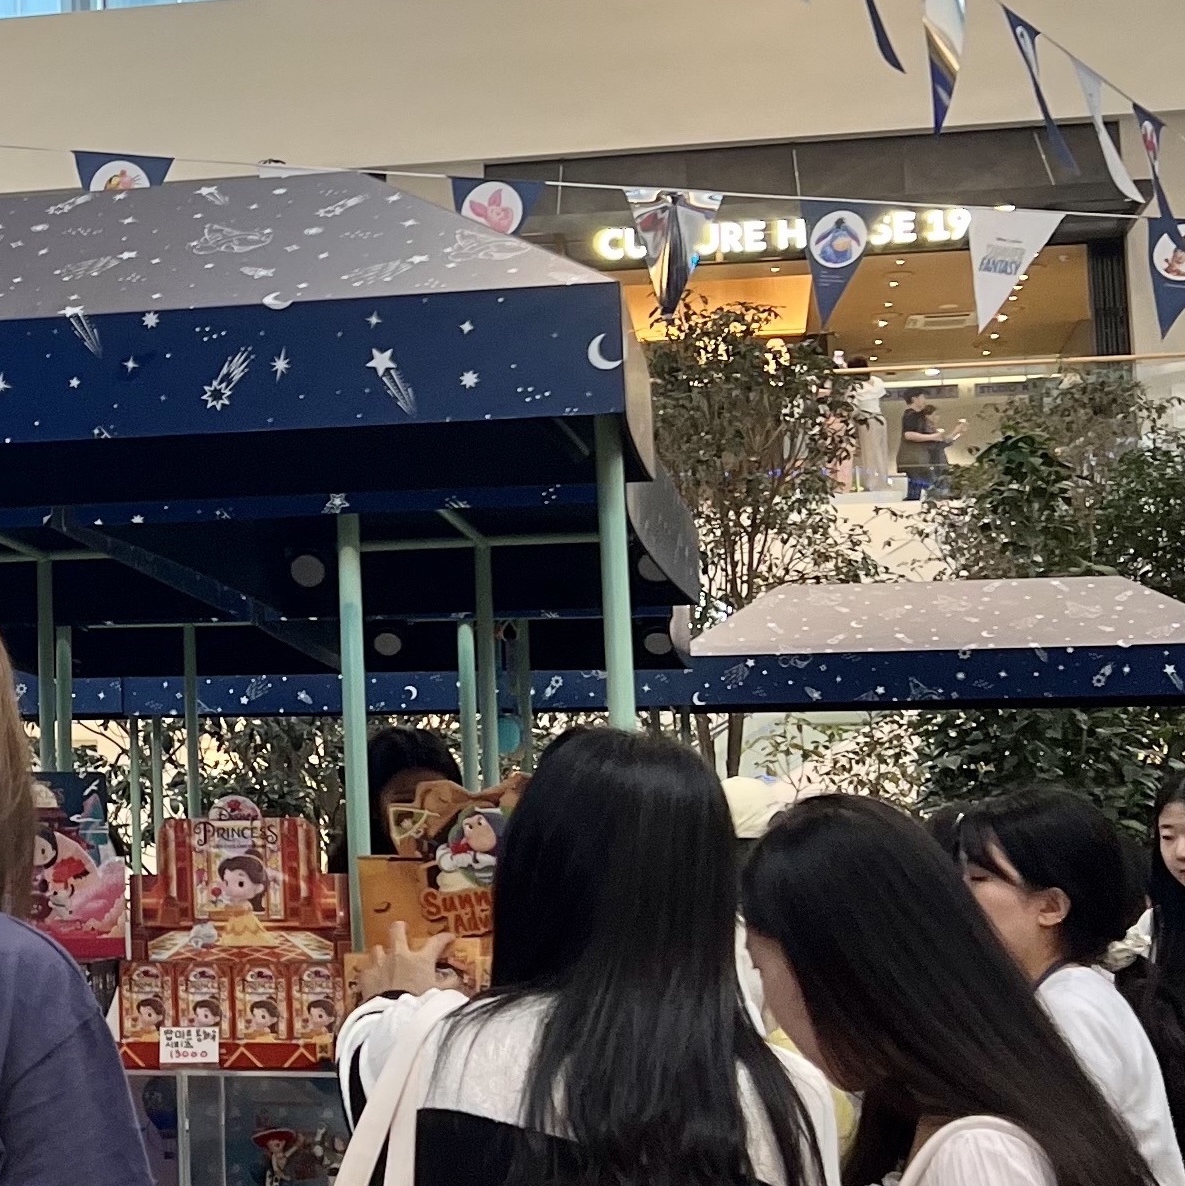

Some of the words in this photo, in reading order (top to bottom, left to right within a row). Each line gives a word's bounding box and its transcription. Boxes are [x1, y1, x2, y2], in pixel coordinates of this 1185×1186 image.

[594, 220, 767, 261] CUURE
[776, 209, 917, 250] HSE
[922, 208, 972, 242] 19
[194, 821, 278, 846] PRINCESS
[421, 890, 493, 918] Sunn
